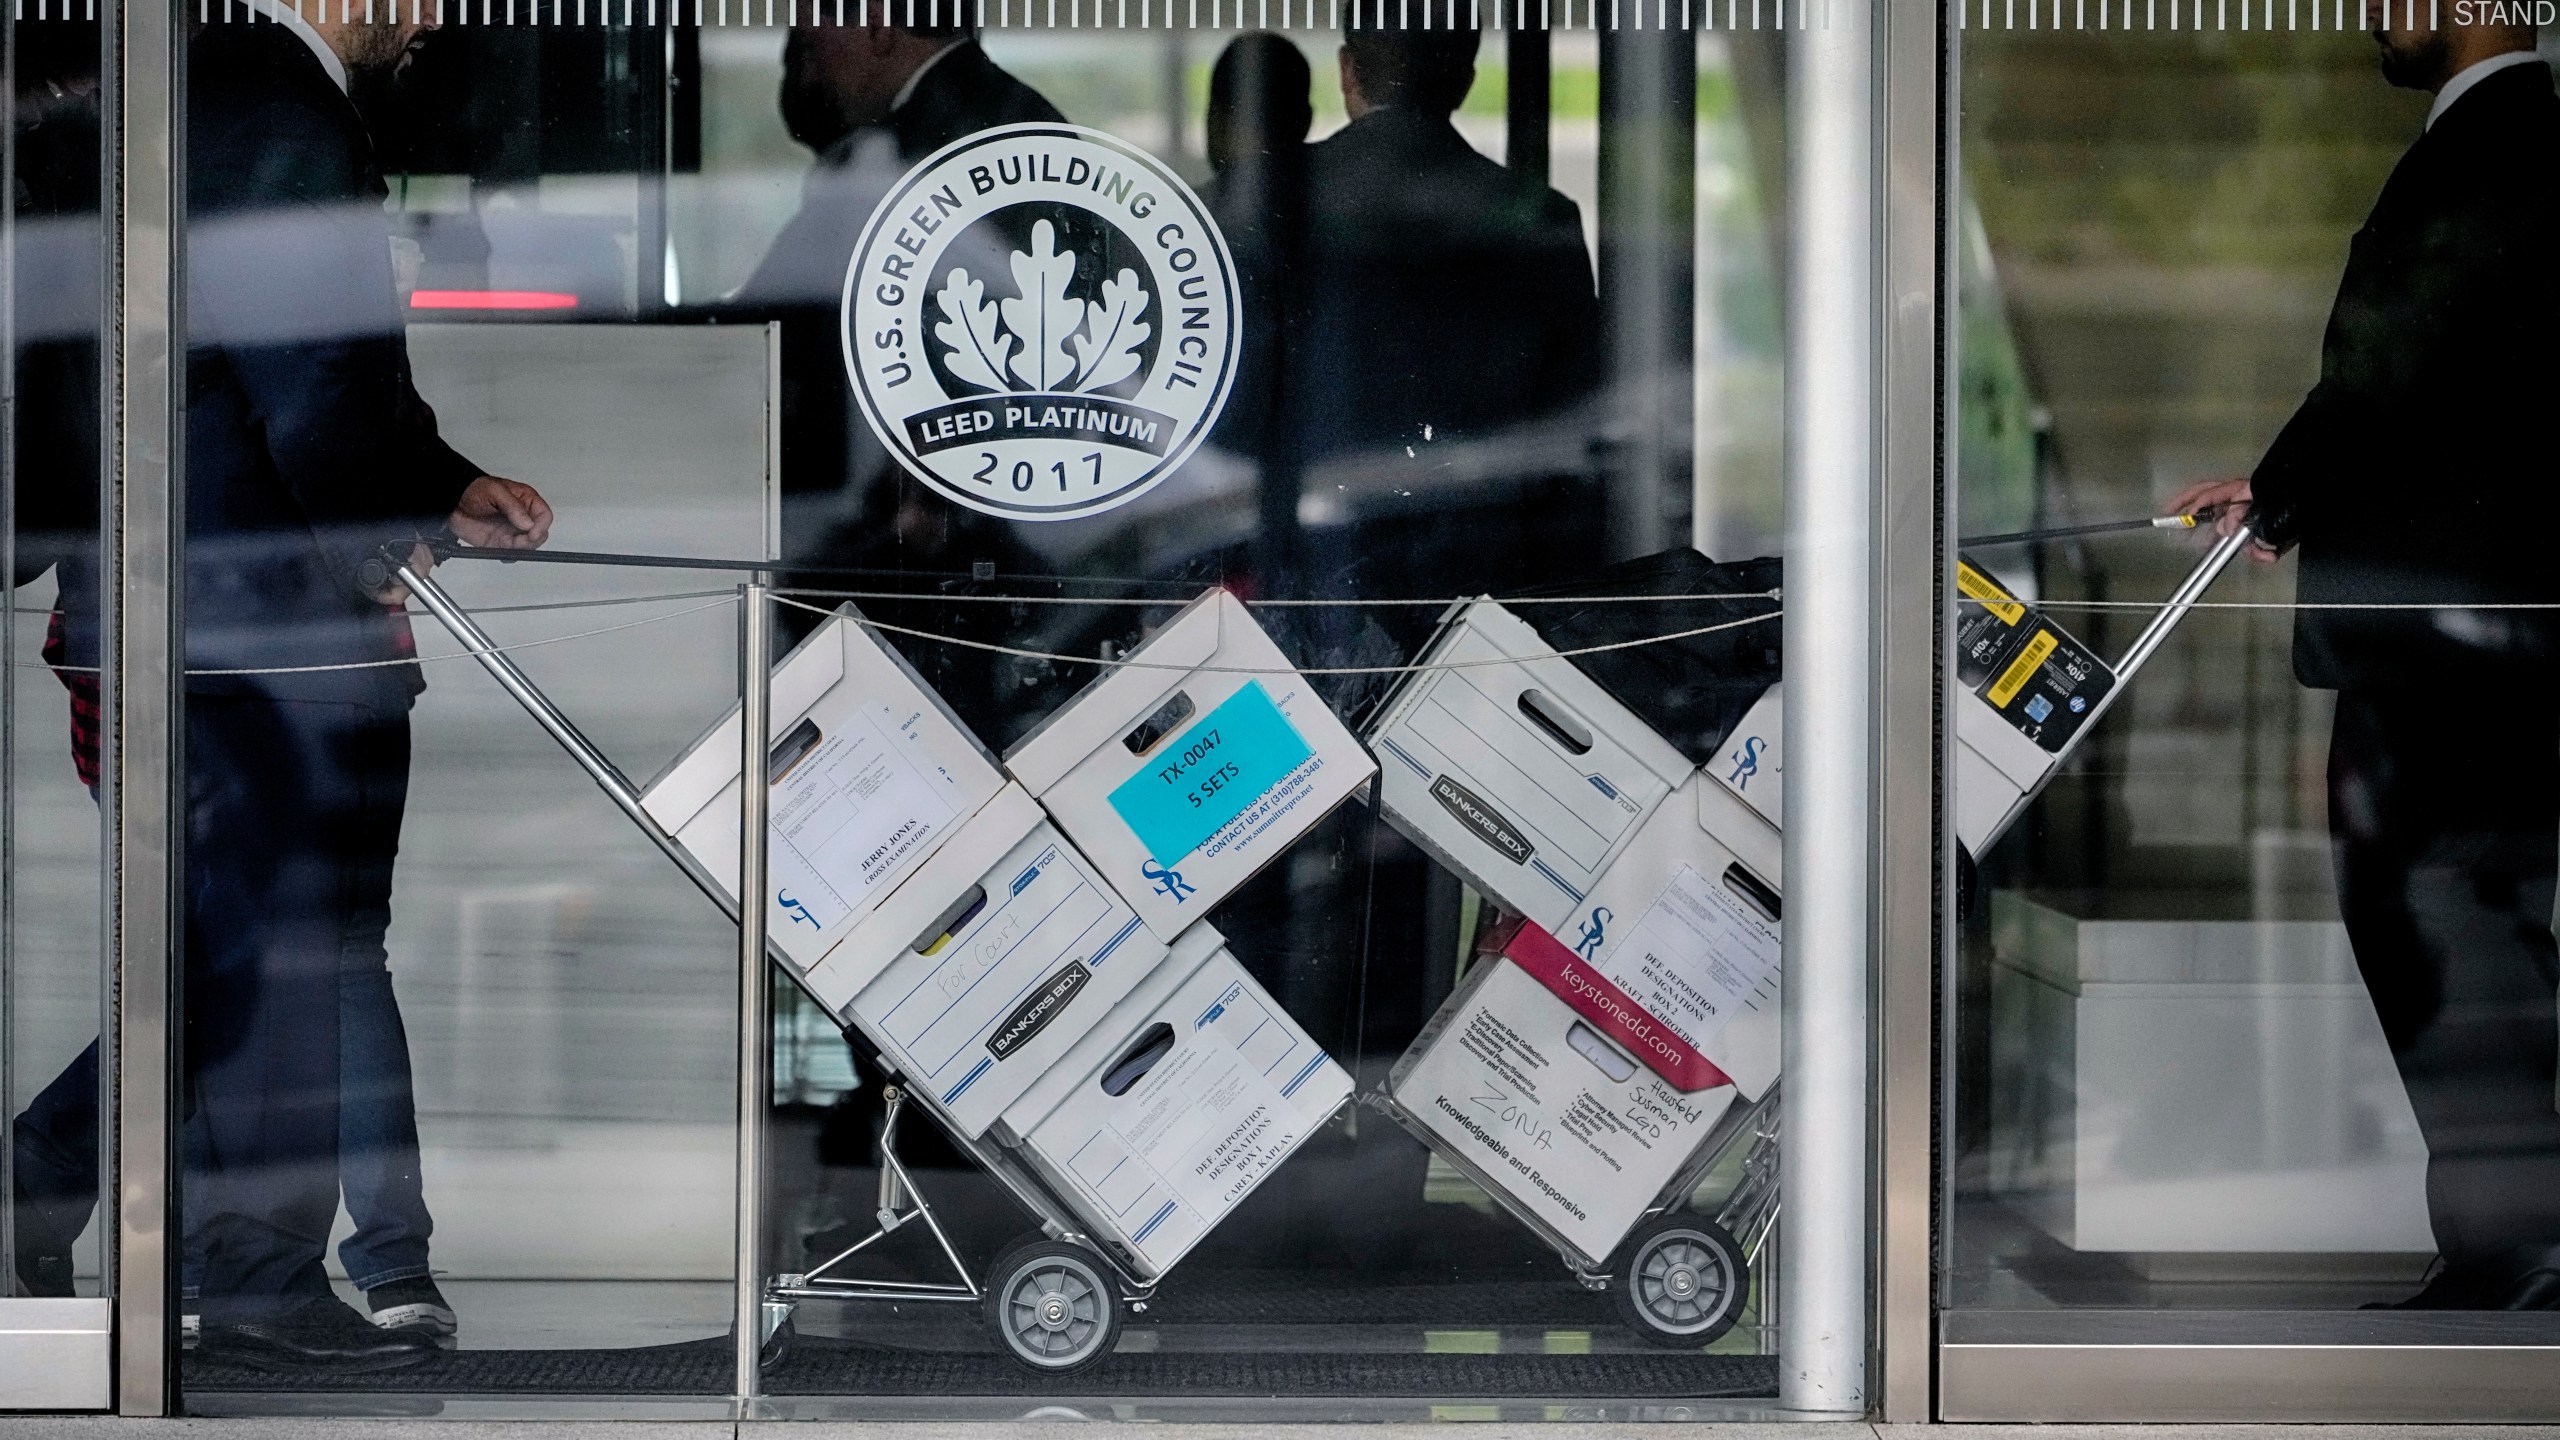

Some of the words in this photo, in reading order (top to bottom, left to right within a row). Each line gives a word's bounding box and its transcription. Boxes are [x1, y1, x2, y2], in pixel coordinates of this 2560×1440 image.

[2454, 0, 2556, 26] STAND
[968, 154, 1156, 219] BUILDING
[876, 184, 963, 306] GREEN
[1156, 223, 1210, 392] COUNCIL
[875, 317, 912, 388] U.S.
[921, 410, 994, 443] LEED
[1006, 407, 1157, 443] PLATINUM
[973, 452, 1102, 492] 2017
[2047, 679, 2070, 698] LASERJET
[1158, 729, 1221, 785] TX-0047
[1188, 792, 1202, 808] 5
[1201, 762, 1239, 798] SETS
[1207, 822, 1246, 858] CONTACT
[1245, 812, 1260, 825] US
[1259, 801, 1271, 816] AT
[1271, 758, 1324, 806] (310)788-3481
[1234, 784, 1314, 852] www.summittrepro.net
[1439, 784, 1498, 835] BANKERS
[1496, 830, 1526, 857] BOX
[861, 843, 889, 872] JERRY
[889, 819, 917, 846] JONES
[865, 864, 886, 885] CROSS
[885, 823, 930, 867] EXAMINATION
[937, 960, 968, 999] For
[1641, 966, 1706, 1022] DESIGNATIONS
[1645, 953, 1665, 972] DEF.
[1665, 970, 1718, 1016] DEPOSITION
[1652, 992, 1672, 1011] BOX
[1671, 1008, 1678, 1016] 2
[995, 990, 1057, 1051] BANKERS
[1049, 968, 1083, 1004] BOX
[1471, 1023, 1505, 1053] E-Discovery
[1482, 1009, 1507, 1032] Forensic
[1506, 1029, 1520, 1043] Data
[1519, 1040, 1550, 1067] Collections
[1561, 963, 1682, 1066] keystonedd.com
[1613, 975, 1644, 1002] KRAFT
[1644, 1005, 1700, 1054] SCHROEDER
[1466, 1029, 1496, 1057] Traditional
[1493, 1051, 1537, 1095] Paper/Scanning
[1476, 1015, 1491, 1032] Early
[1489, 1027, 1505, 1042] Case
[1502, 1038, 1540, 1070] Assessment
[1459, 1037, 1488, 1063] Discovery
[1486, 1060, 1500, 1072] and
[1498, 1068, 1512, 1082] Trial
[1510, 1078, 1541, 1106] Production
[1567, 1112, 1581, 1126] Trial
[1579, 1122, 1593, 1137] Prep
[1572, 1106, 1590, 1122] Legal
[1587, 1118, 1603, 1132] Hold
[1578, 1099, 1596, 1117] Cyber
[1591, 1112, 1618, 1134] Security
[1583, 1093, 1608, 1114] Attorney
[1606, 1111, 1633, 1134] Managed
[1631, 1131, 1652, 1150] Review
[1629, 1087, 1685, 1131] Susman
[1196, 1156, 1217, 1176] DEF.
[1215, 1104, 1266, 1156] DEPOSITION
[1209, 1118, 1272, 1180] DESIGNATIONS
[1224, 1171, 1254, 1202] CAREY
[1257, 1135, 1293, 1169] KAPLAN
[1236, 1151, 1257, 1172] BOX
[1435, 1095, 1510, 1159] Knowledgeable
[1509, 1157, 1532, 1176] and
[1529, 1171, 1586, 1222] Responsive
[1560, 1119, 1590, 1145] Blueprints
[1589, 1143, 1602, 1154] and
[1600, 1151, 1622, 1173] Plotting
